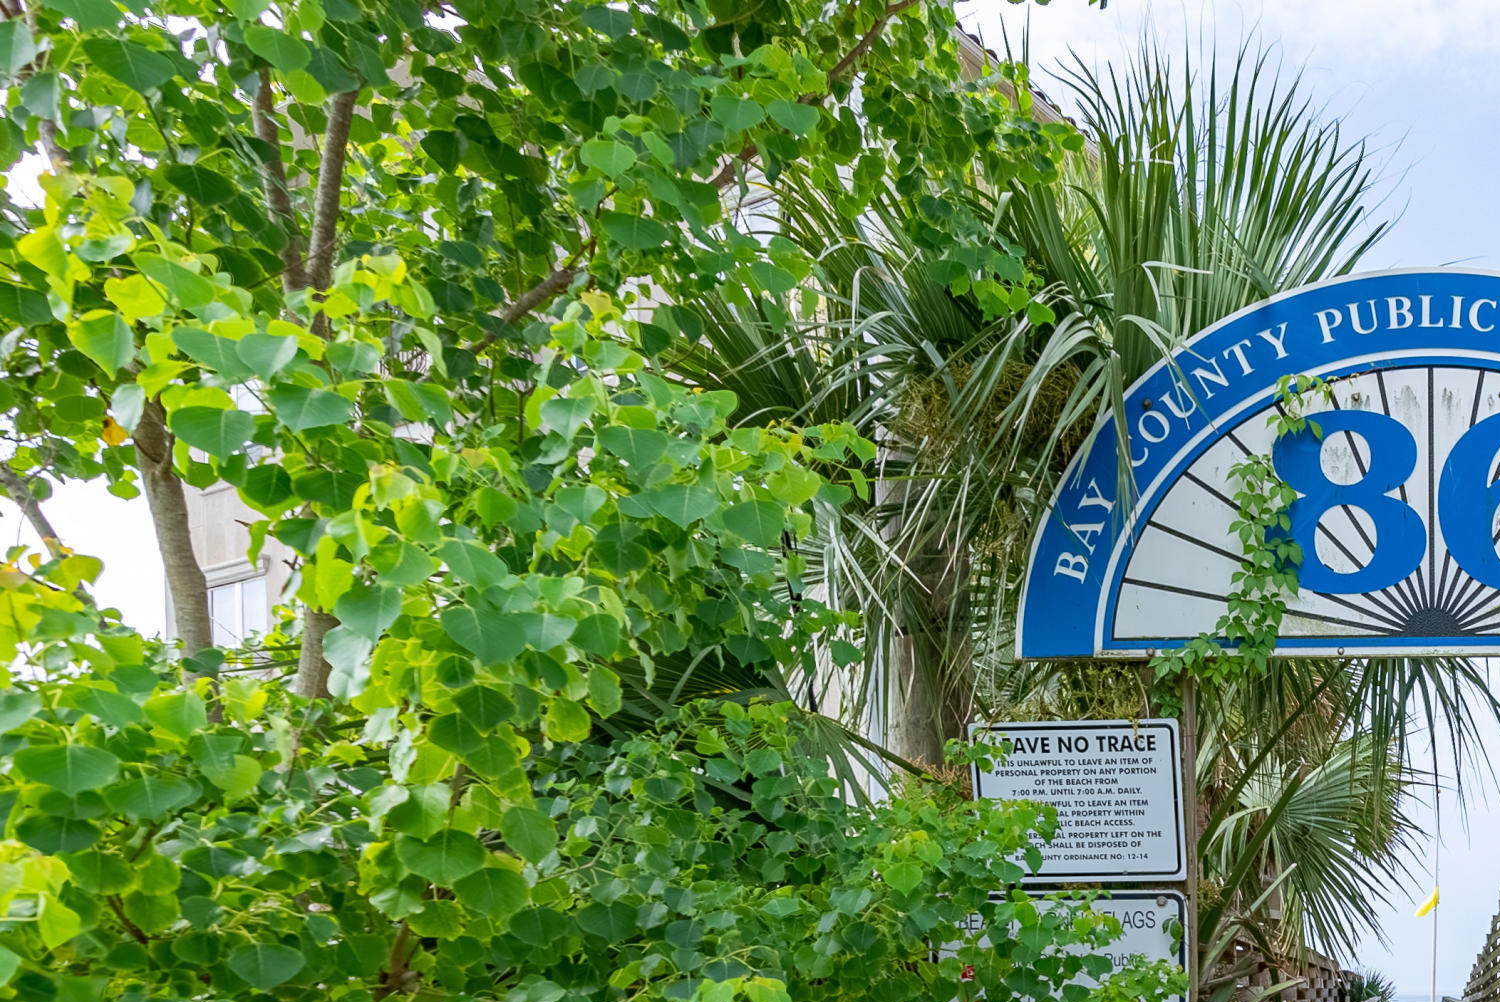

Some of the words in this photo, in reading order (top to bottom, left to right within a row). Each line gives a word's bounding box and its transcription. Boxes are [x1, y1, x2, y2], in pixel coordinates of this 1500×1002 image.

[1053, 481, 1117, 585] BAY
[1130, 322, 1290, 467] COUNTY
[1316, 295, 1498, 344] PUBLIC
[1058, 736, 1089, 753] NO
[1096, 735, 1156, 752] TRACE
[995, 769, 1038, 777] PERSONAL
